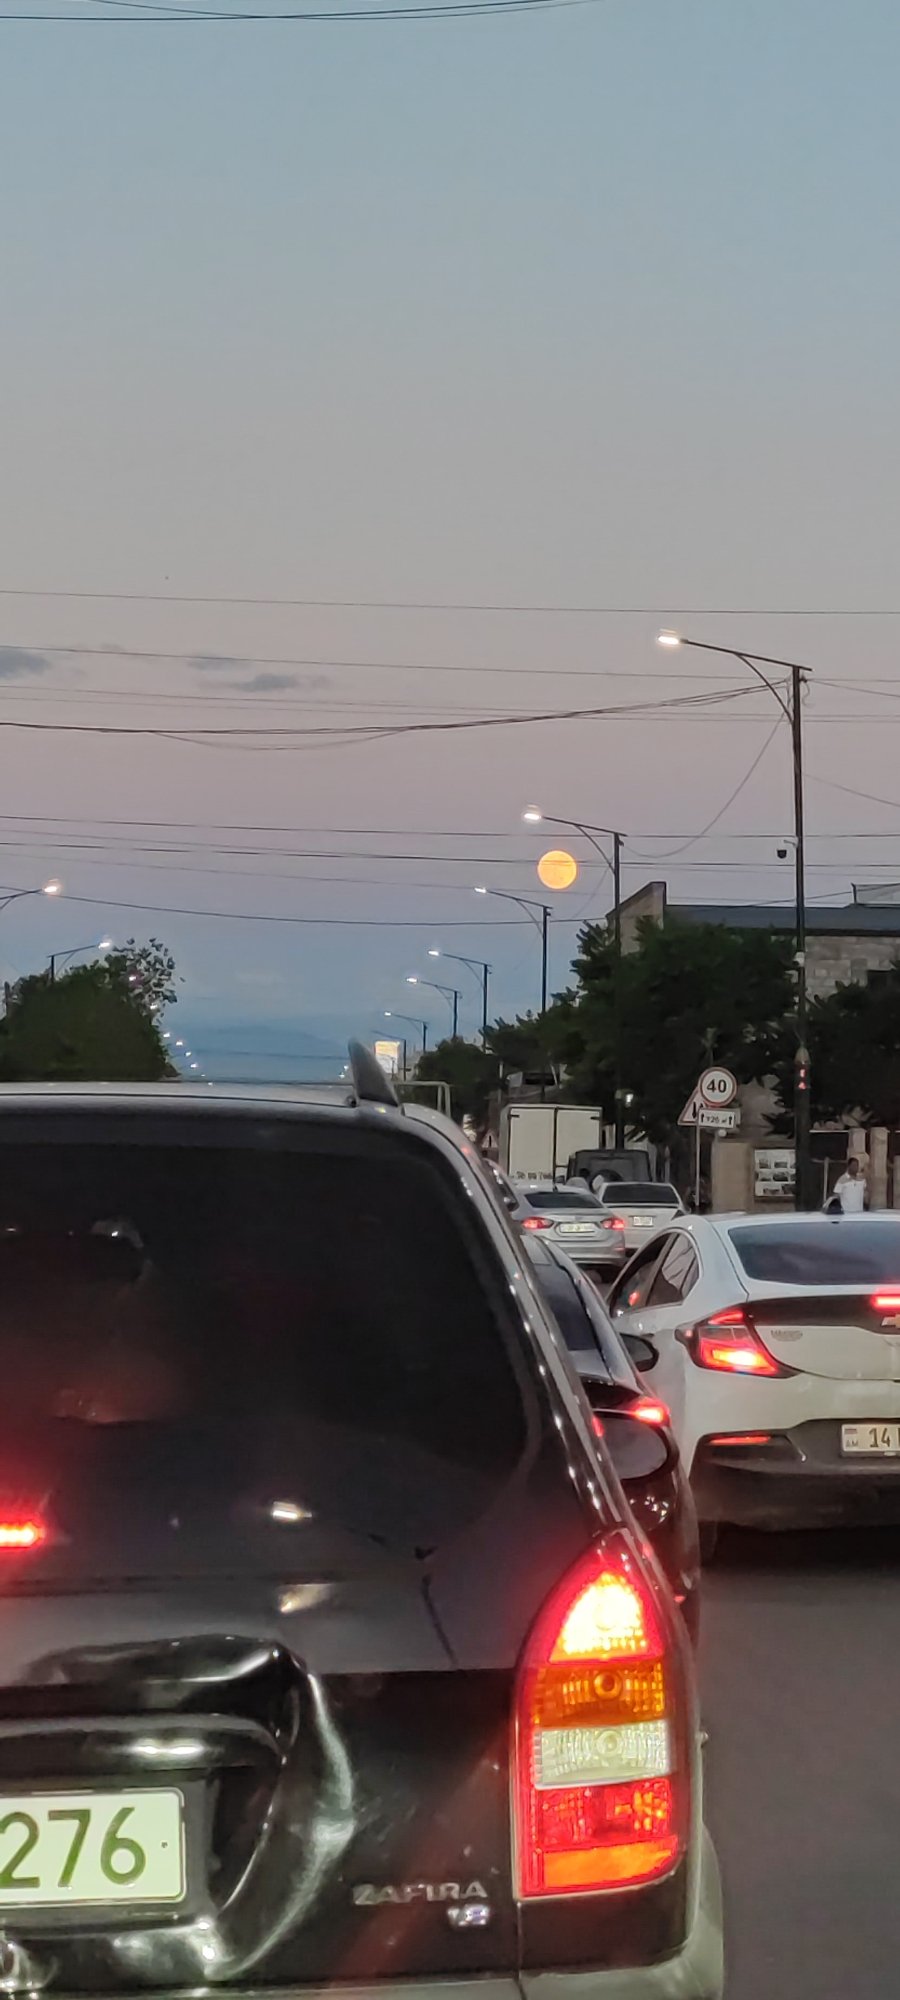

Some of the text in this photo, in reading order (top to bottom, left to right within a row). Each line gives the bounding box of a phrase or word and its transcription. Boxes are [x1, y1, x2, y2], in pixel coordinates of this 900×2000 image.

[706, 1079, 727, 1093] 40
[869, 1428, 891, 1448] 14
[0, 1807, 146, 1888] 276
[353, 1881, 488, 1905] ZAFIRA
